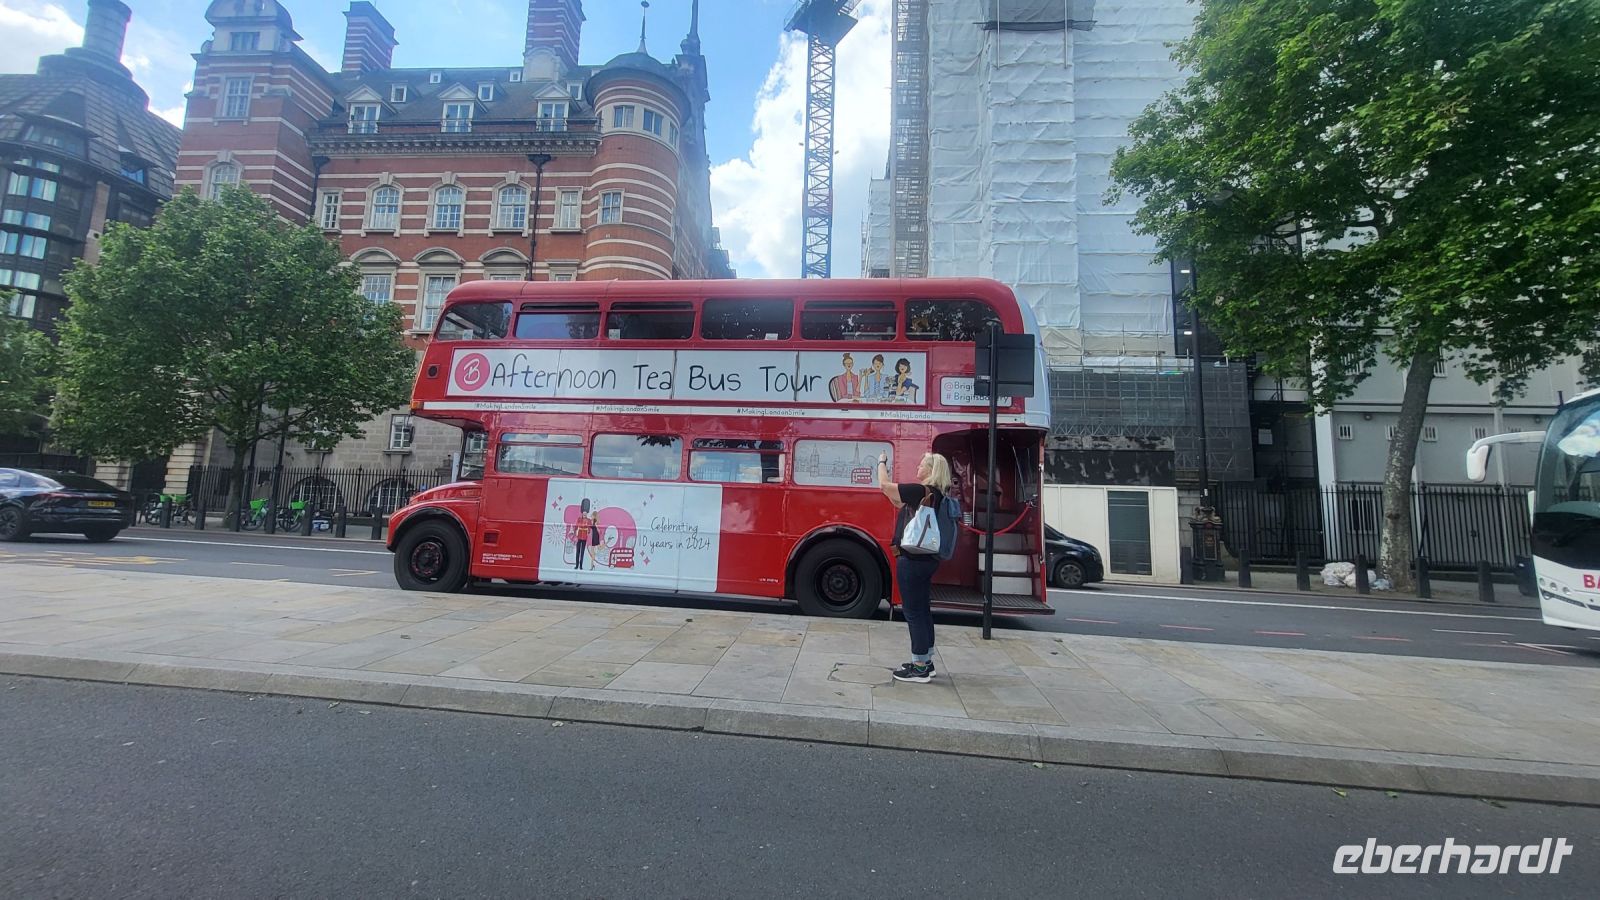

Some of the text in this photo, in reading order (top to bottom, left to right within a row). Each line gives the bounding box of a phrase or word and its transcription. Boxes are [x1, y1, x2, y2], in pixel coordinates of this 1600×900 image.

[491, 353, 822, 393] Afternoon Tea Bus Tour
[650, 516, 699, 538] Celebrating
[638, 535, 711, 554] 10 years in 2024
[1584, 575, 1600, 589] B
